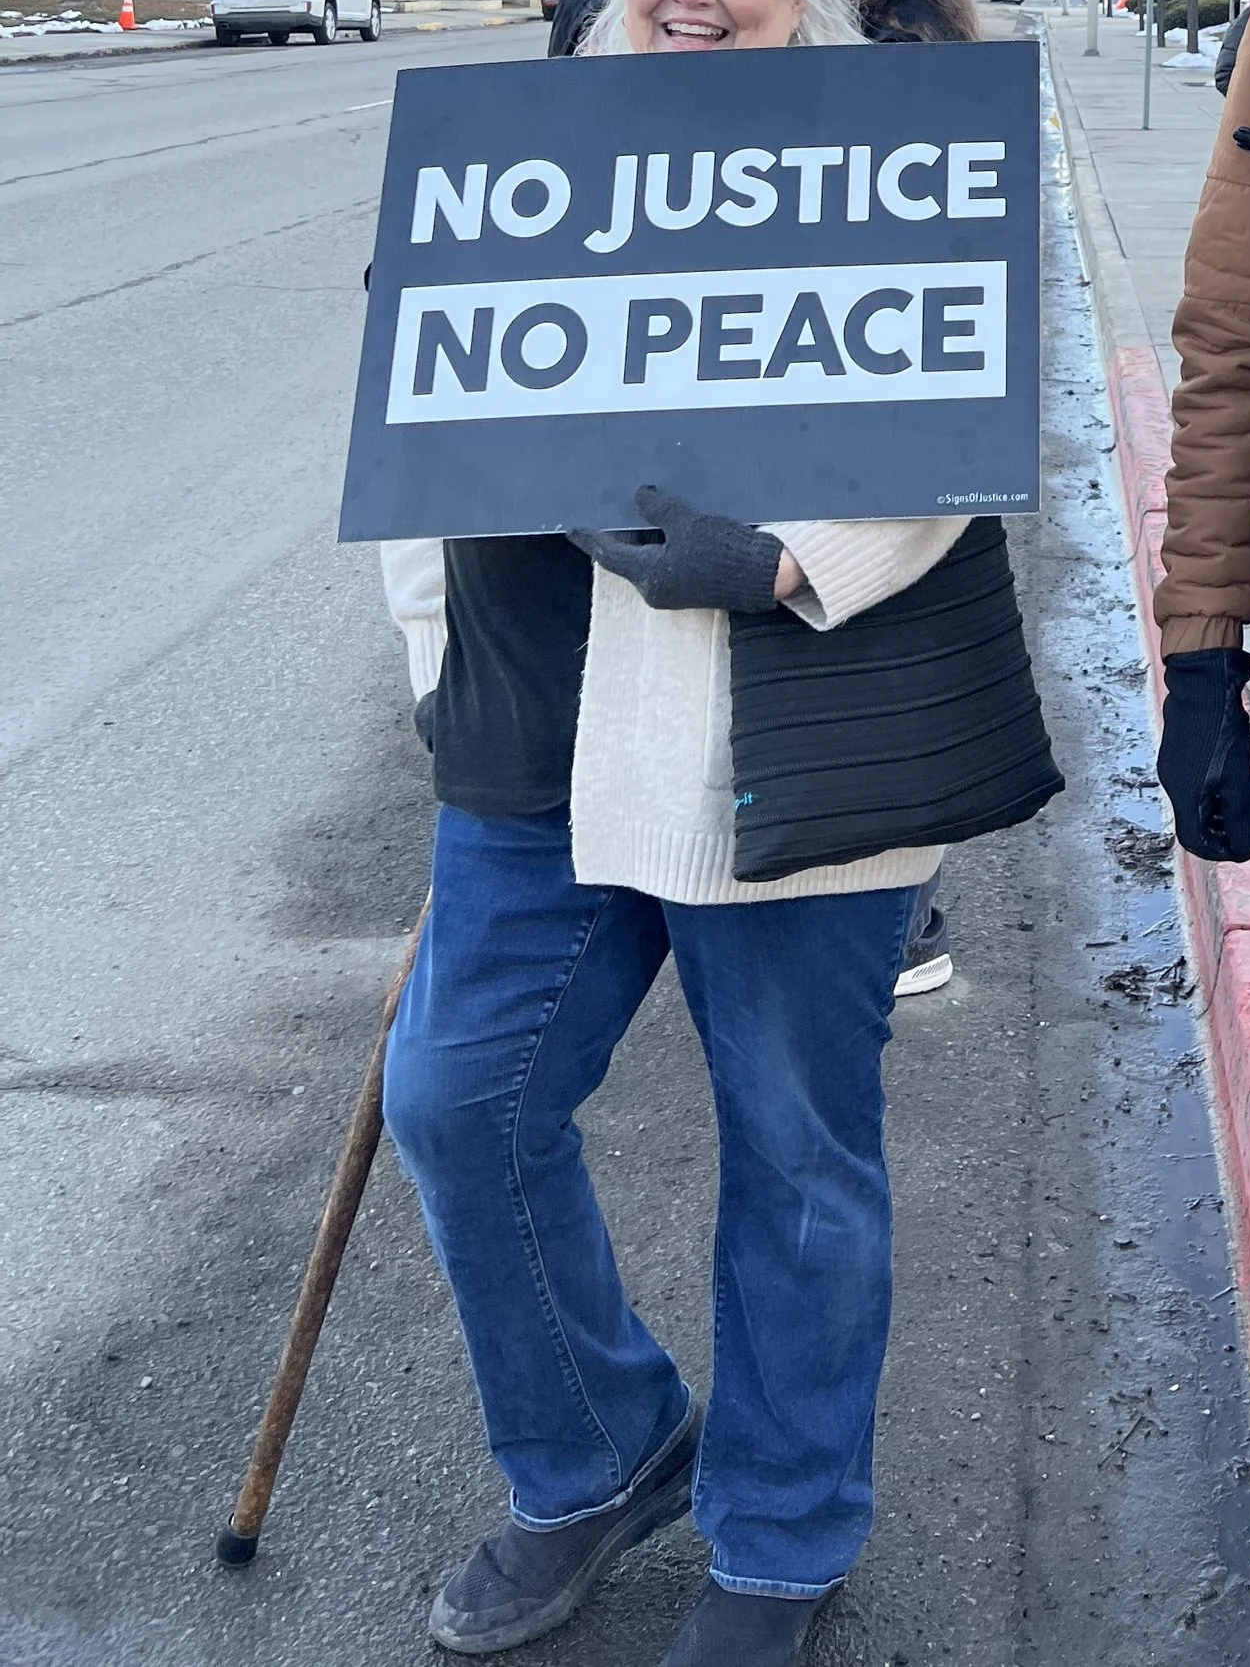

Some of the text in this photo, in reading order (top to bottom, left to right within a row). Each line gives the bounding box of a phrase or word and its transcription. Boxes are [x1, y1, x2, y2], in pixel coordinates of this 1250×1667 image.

[411, 141, 1007, 254] NO JUSTICE
[413, 286, 985, 396] NO PEACE
